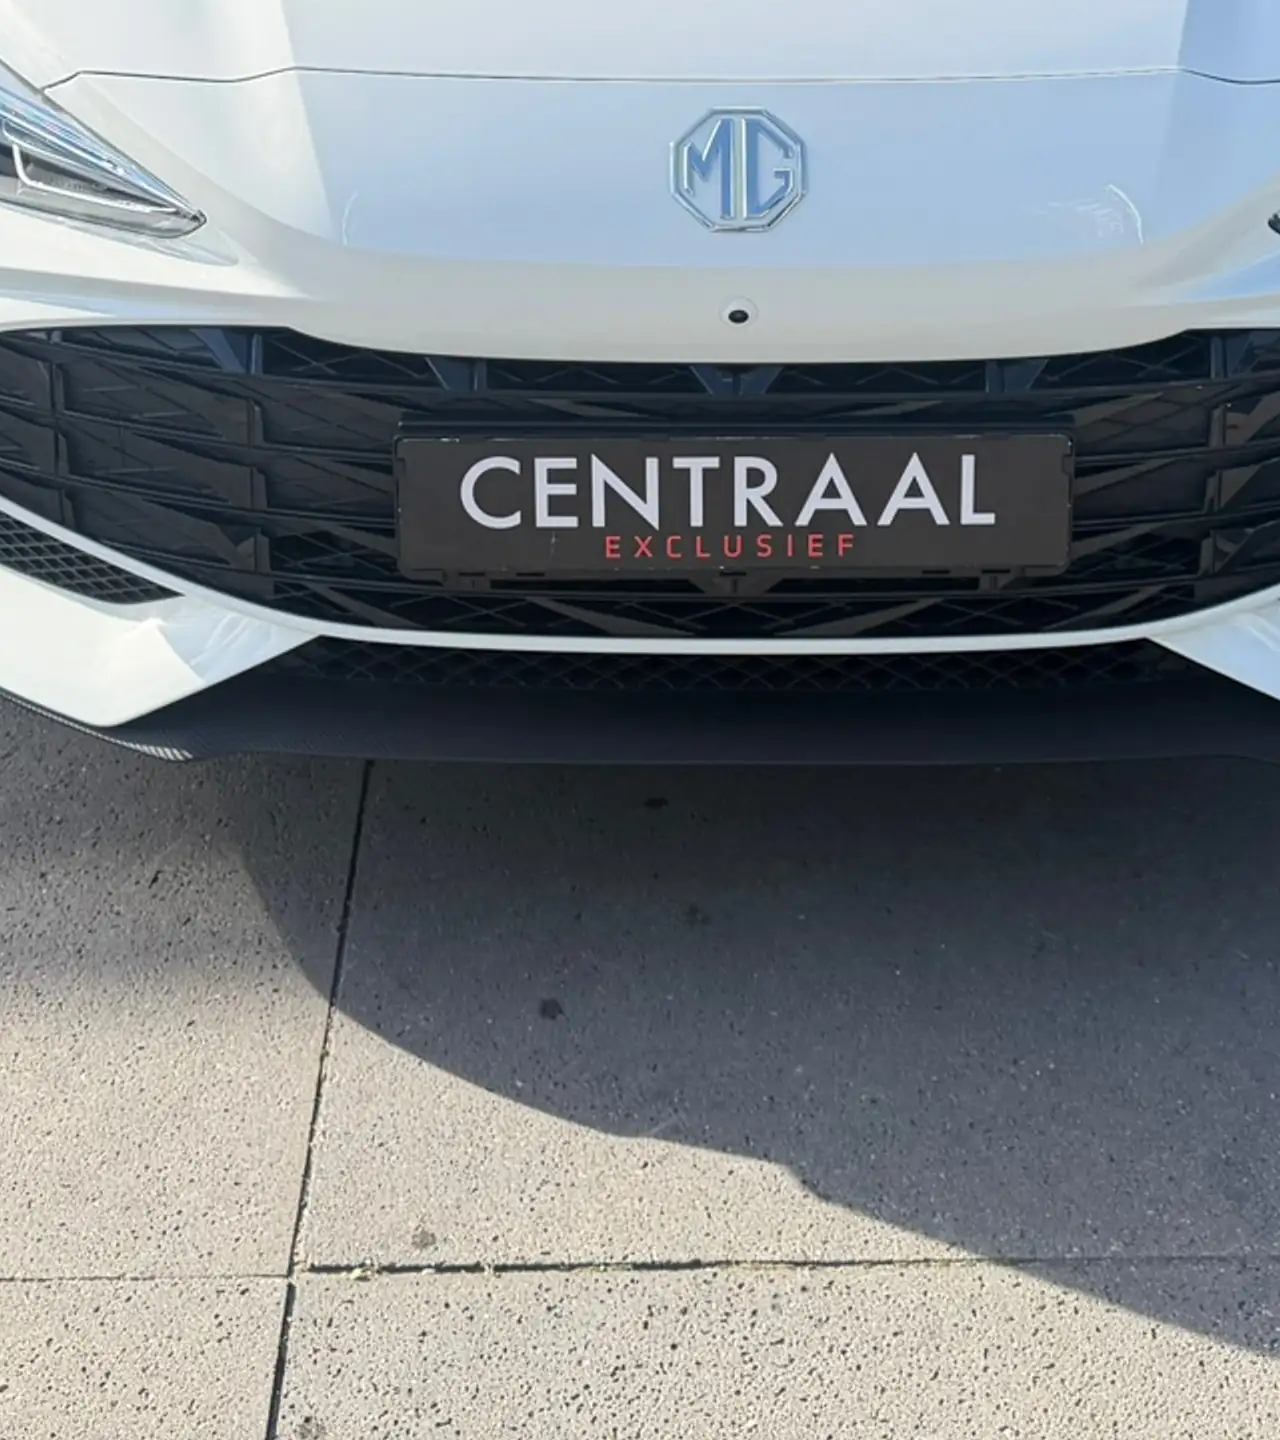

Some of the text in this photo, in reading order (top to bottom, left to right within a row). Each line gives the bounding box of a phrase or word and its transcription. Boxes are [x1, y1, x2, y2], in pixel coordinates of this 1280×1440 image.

[683, 118, 795, 221] MG
[460, 452, 996, 530] CENTRAAL
[605, 533, 856, 559] EXCLUSIEF
